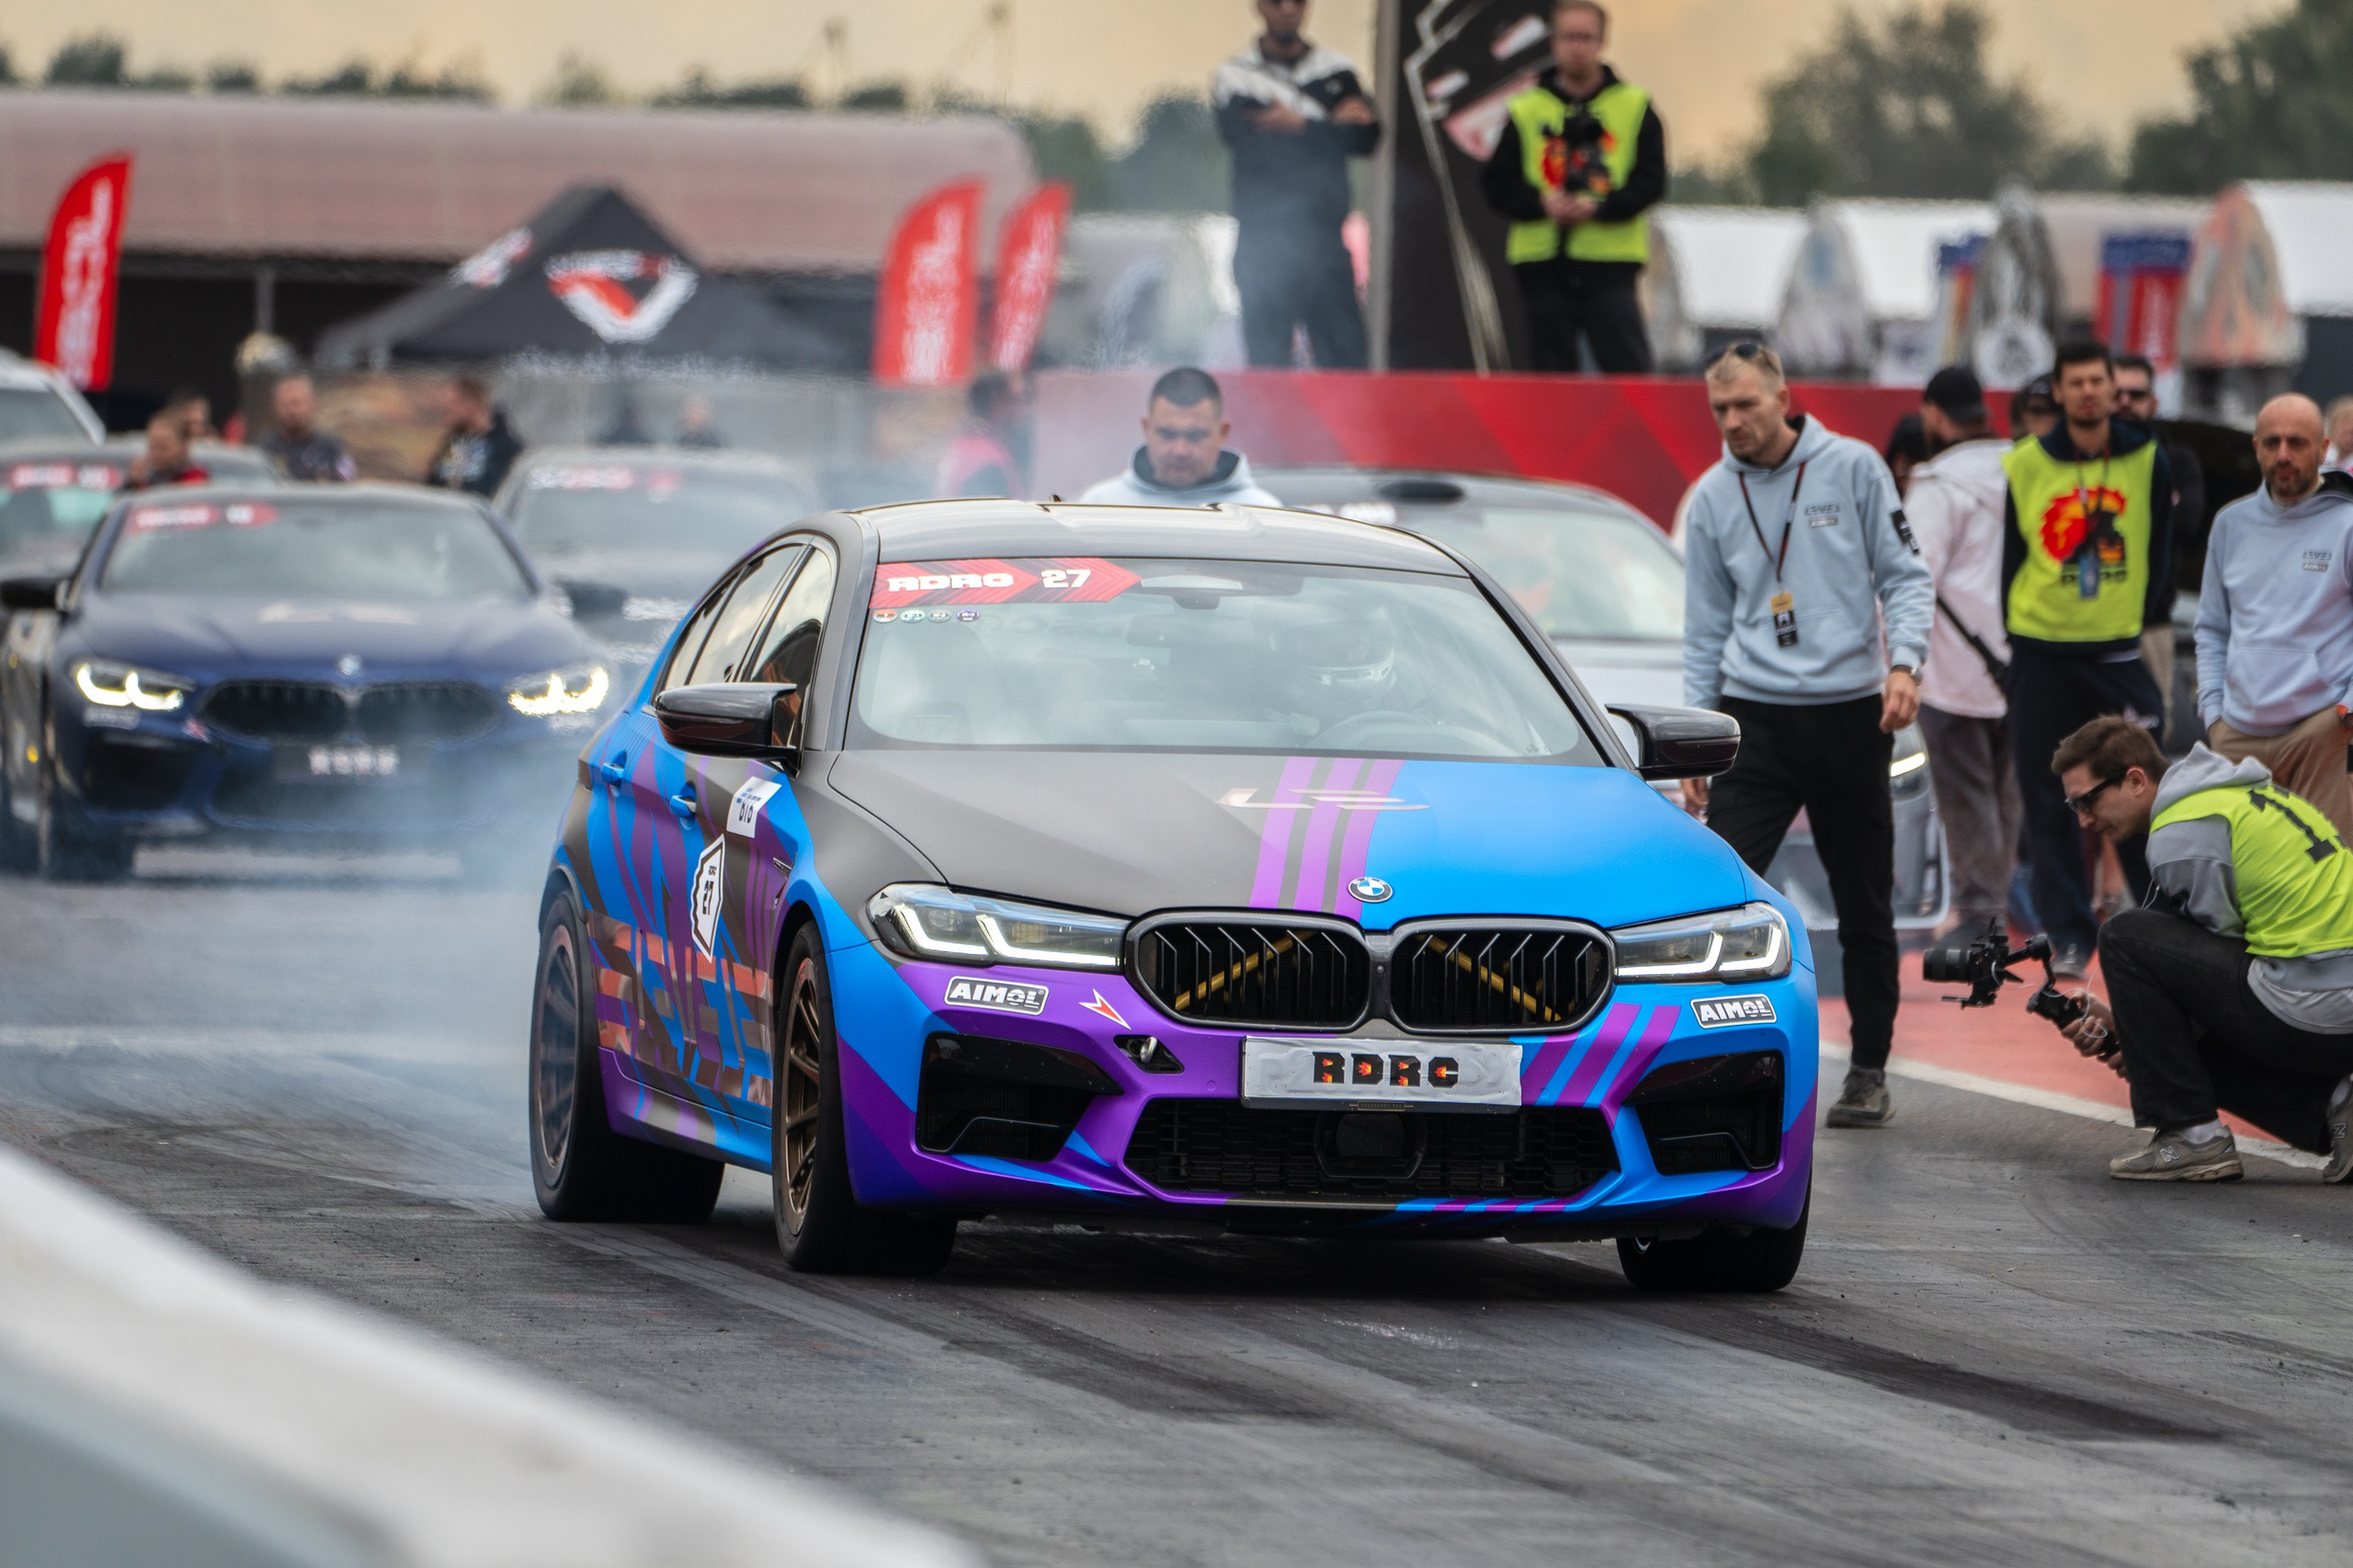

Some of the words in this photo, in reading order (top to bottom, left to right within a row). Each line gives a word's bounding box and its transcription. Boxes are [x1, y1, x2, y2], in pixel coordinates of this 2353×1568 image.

[1040, 569, 1091, 588] 27
[702, 881, 715, 915] 27
[949, 983, 1040, 1009] AIMOL
[1699, 1000, 1773, 1022] AIMOL
[1313, 1051, 1459, 1088] RDRC
